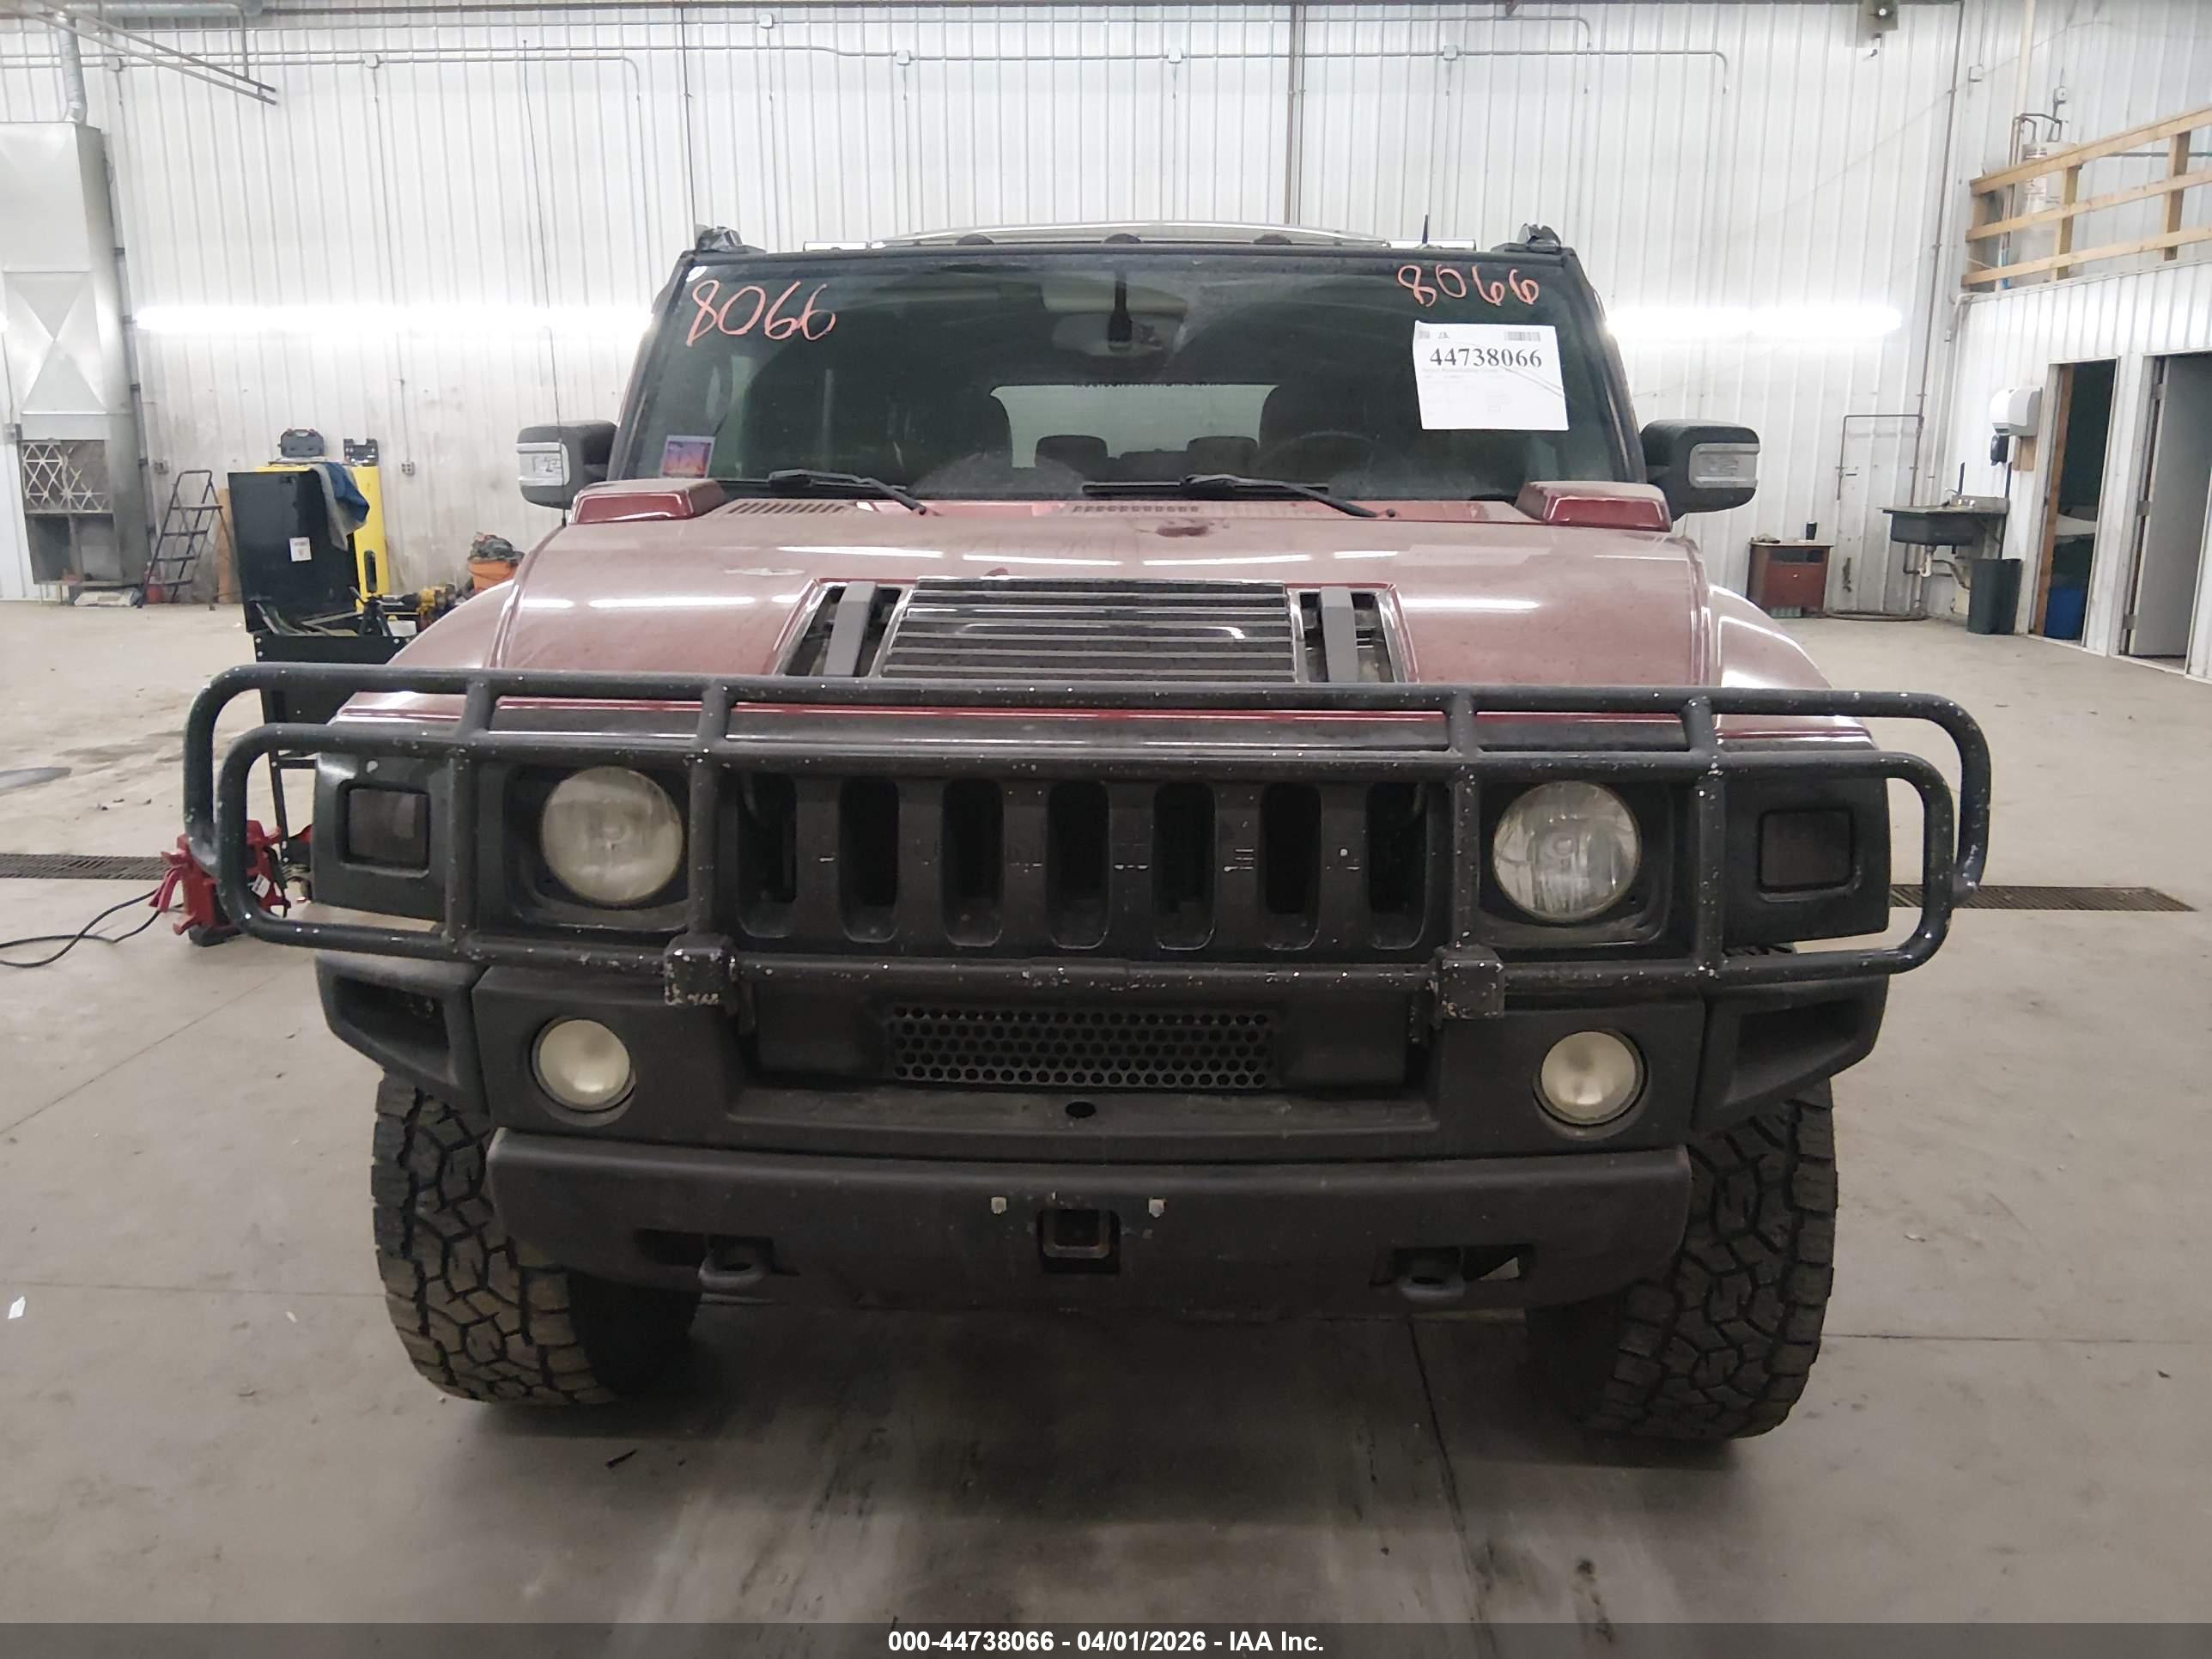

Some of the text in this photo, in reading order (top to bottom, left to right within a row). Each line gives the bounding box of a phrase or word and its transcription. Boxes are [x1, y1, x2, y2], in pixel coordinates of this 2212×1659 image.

[1397, 264, 1540, 307] 8066
[686, 279, 837, 348] 8066
[1430, 347, 1542, 368] 44738066
